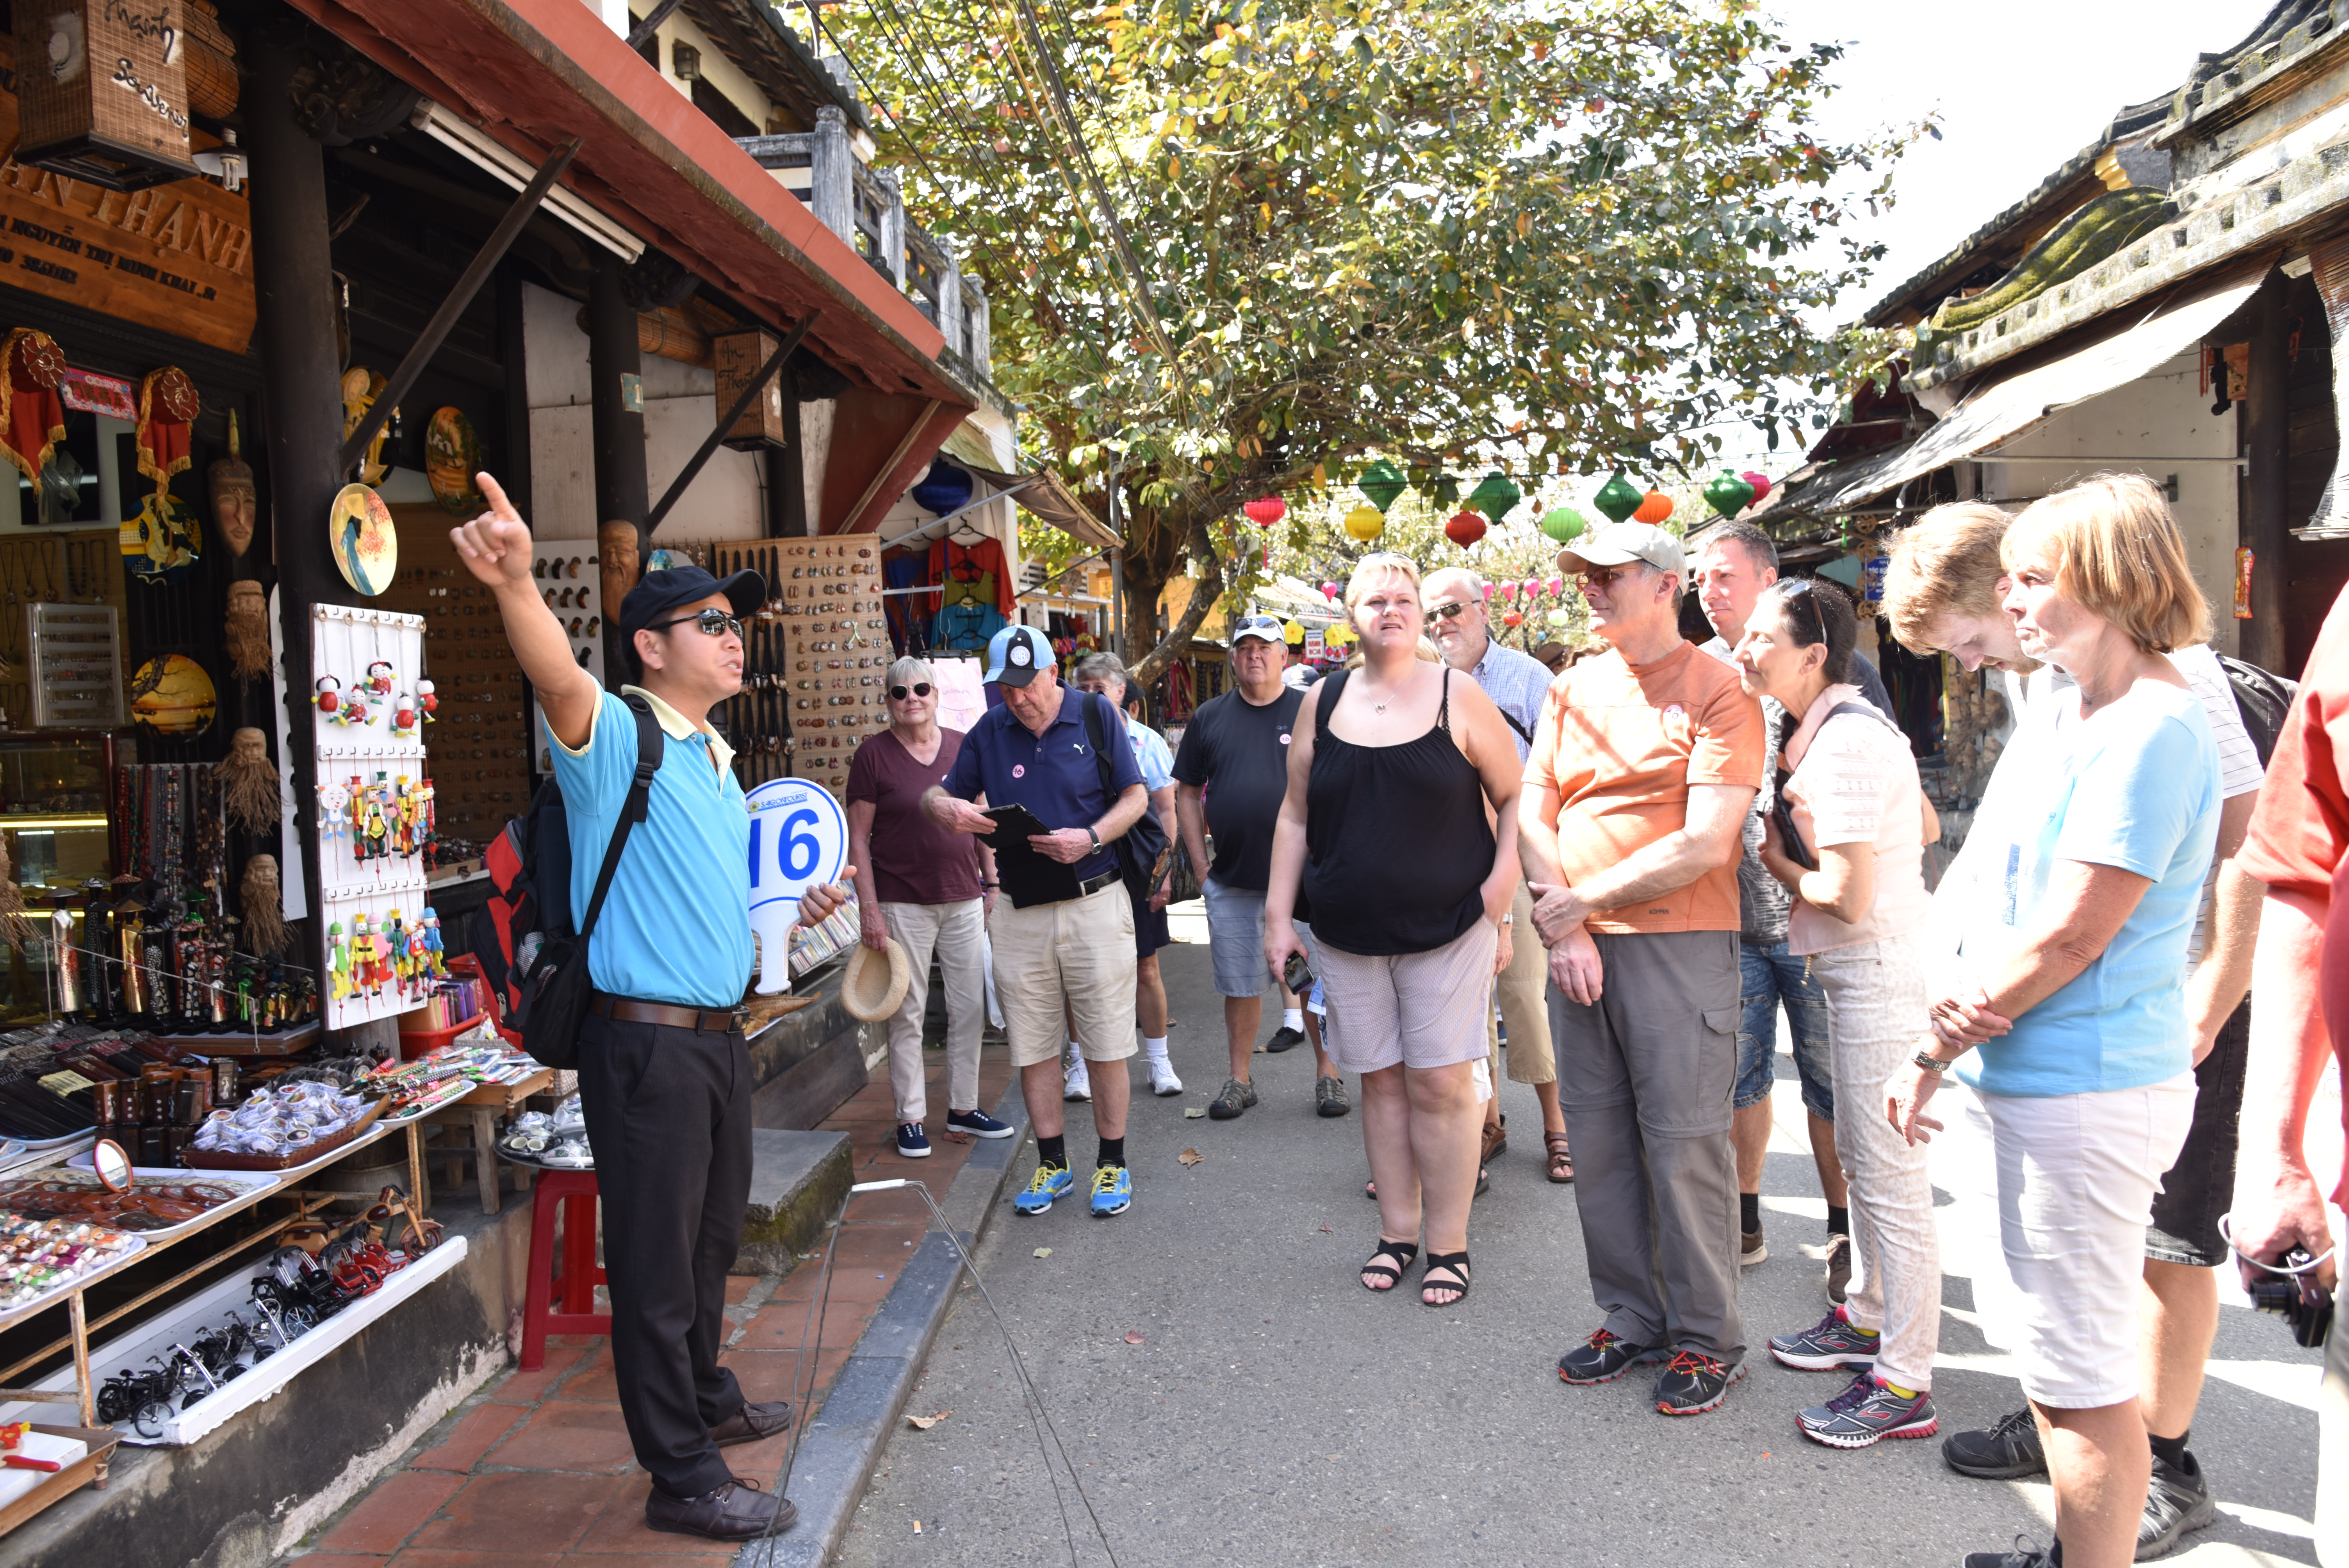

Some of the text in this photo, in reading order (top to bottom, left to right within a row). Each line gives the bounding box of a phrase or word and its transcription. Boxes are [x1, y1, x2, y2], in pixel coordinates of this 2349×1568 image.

[116, 255, 159, 281] MINH
[159, 271, 198, 294] KHAI
[1666, 709, 1679, 719] 16
[760, 791, 808, 808] SAIGONTOURIST
[749, 808, 820, 889] 16
